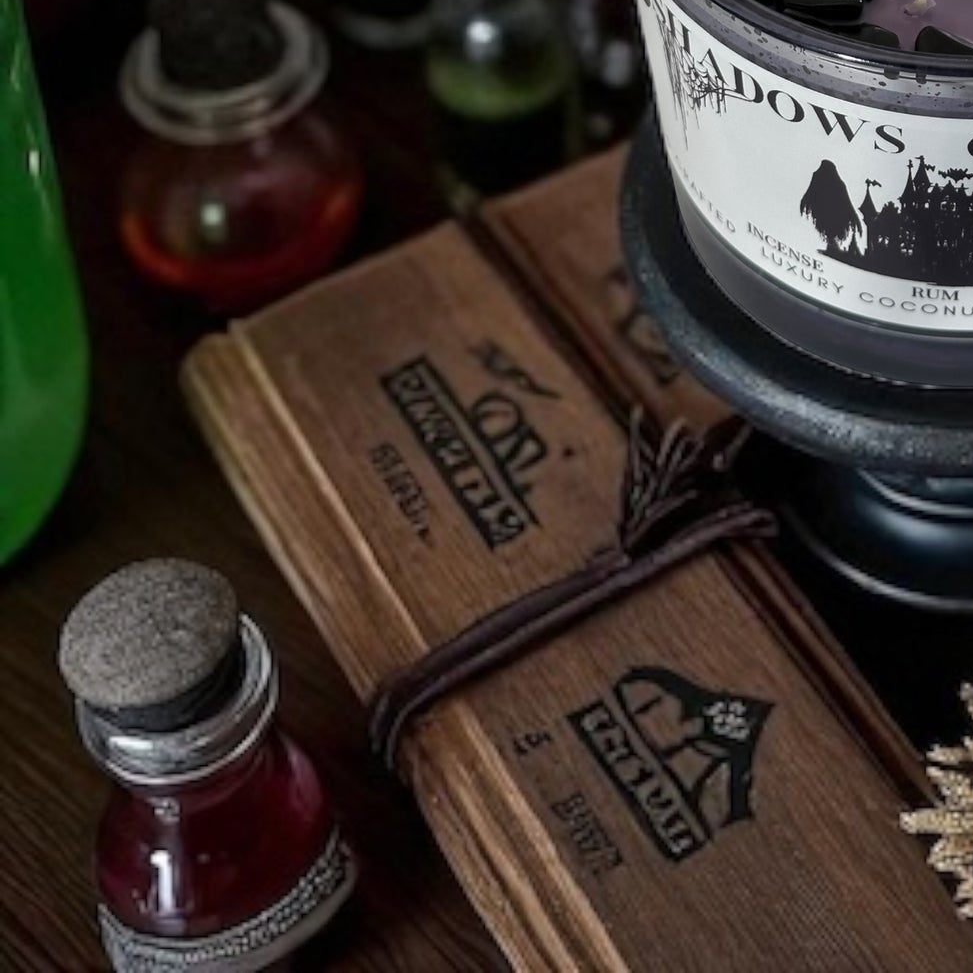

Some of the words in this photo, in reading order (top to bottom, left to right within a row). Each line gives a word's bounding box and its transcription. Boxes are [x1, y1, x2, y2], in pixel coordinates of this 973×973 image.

[746, 221, 824, 273] INCENSE
[761, 246, 844, 294] LUXURY
[911, 285, 960, 302] RUM
